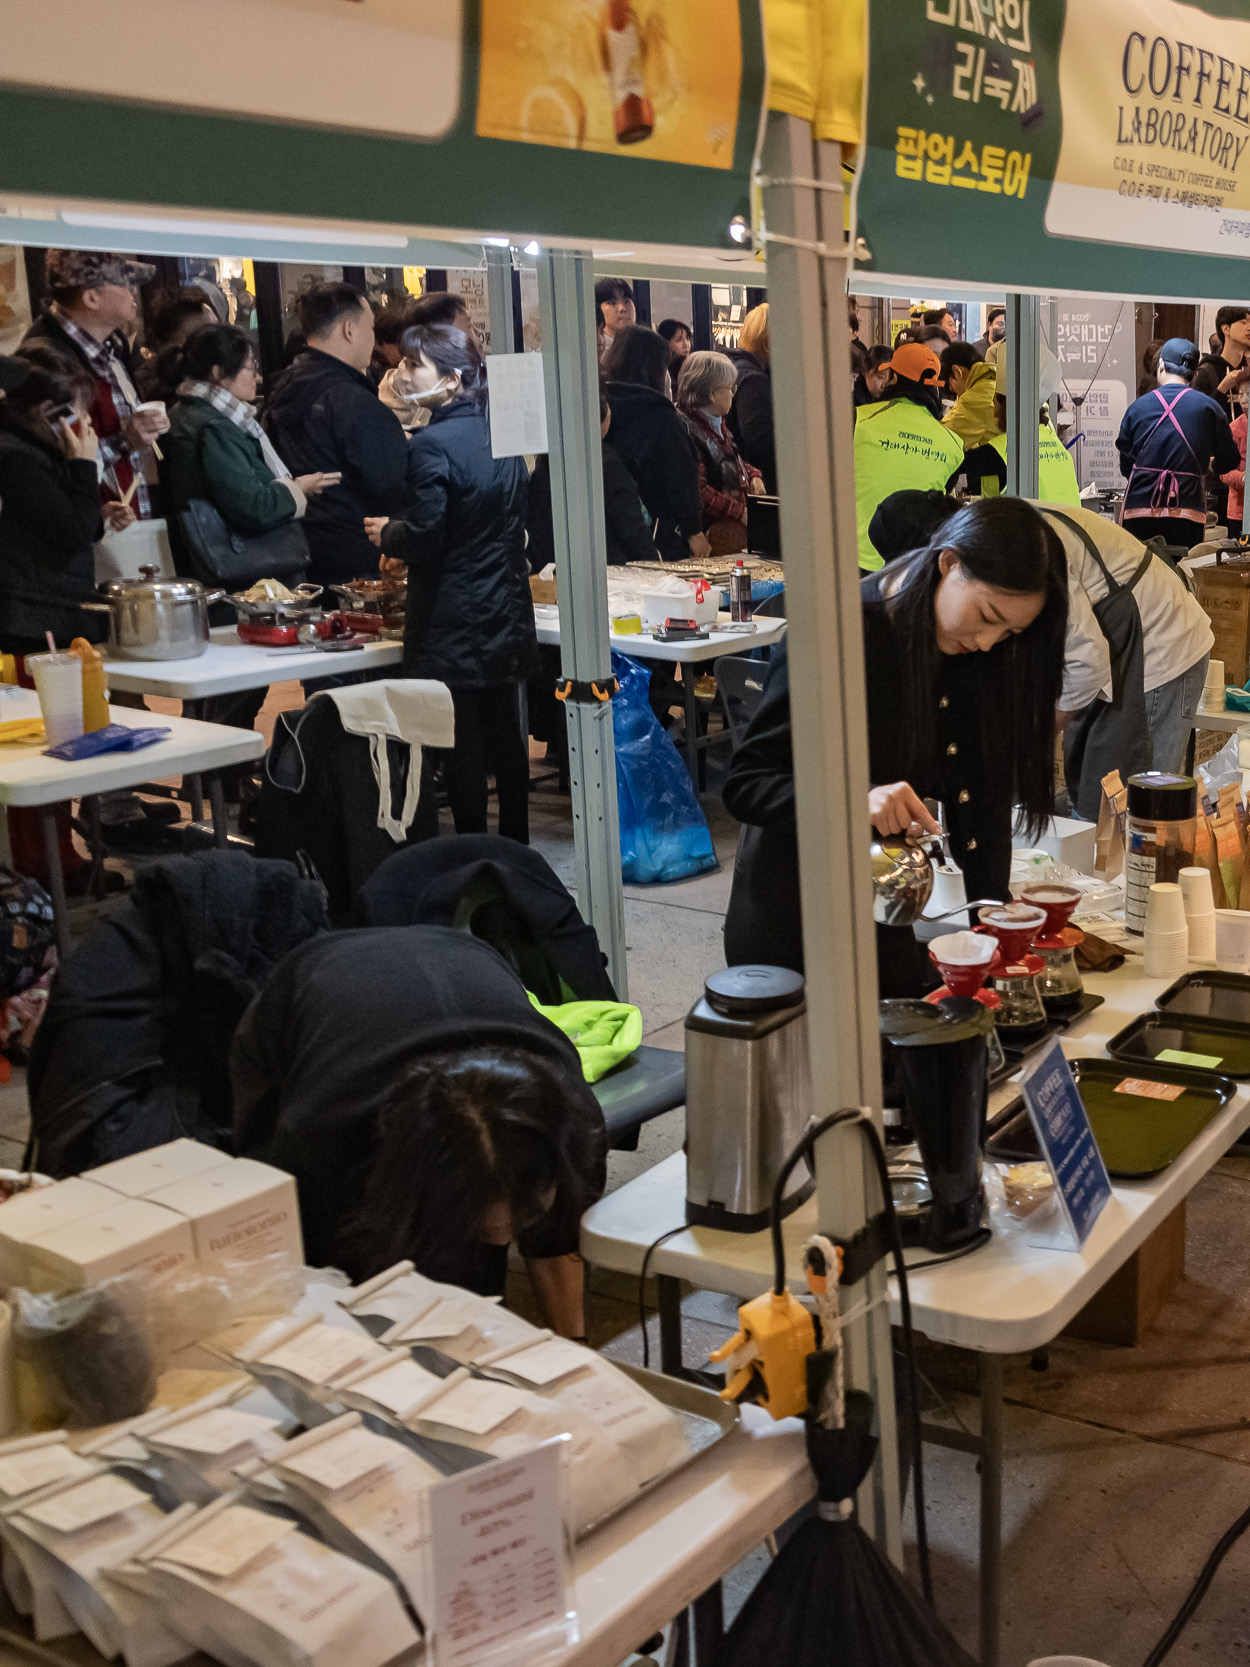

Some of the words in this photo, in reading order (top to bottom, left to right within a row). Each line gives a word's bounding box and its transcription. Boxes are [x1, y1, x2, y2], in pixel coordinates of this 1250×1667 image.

[895, 126, 1031, 199] 팝업스토어
[1116, 106, 1249, 174] LABORATORY
[1145, 163, 1188, 183] SPECIALTY
[1188, 172, 1214, 189] COFFEE
[460, 278, 484, 296] 모닝
